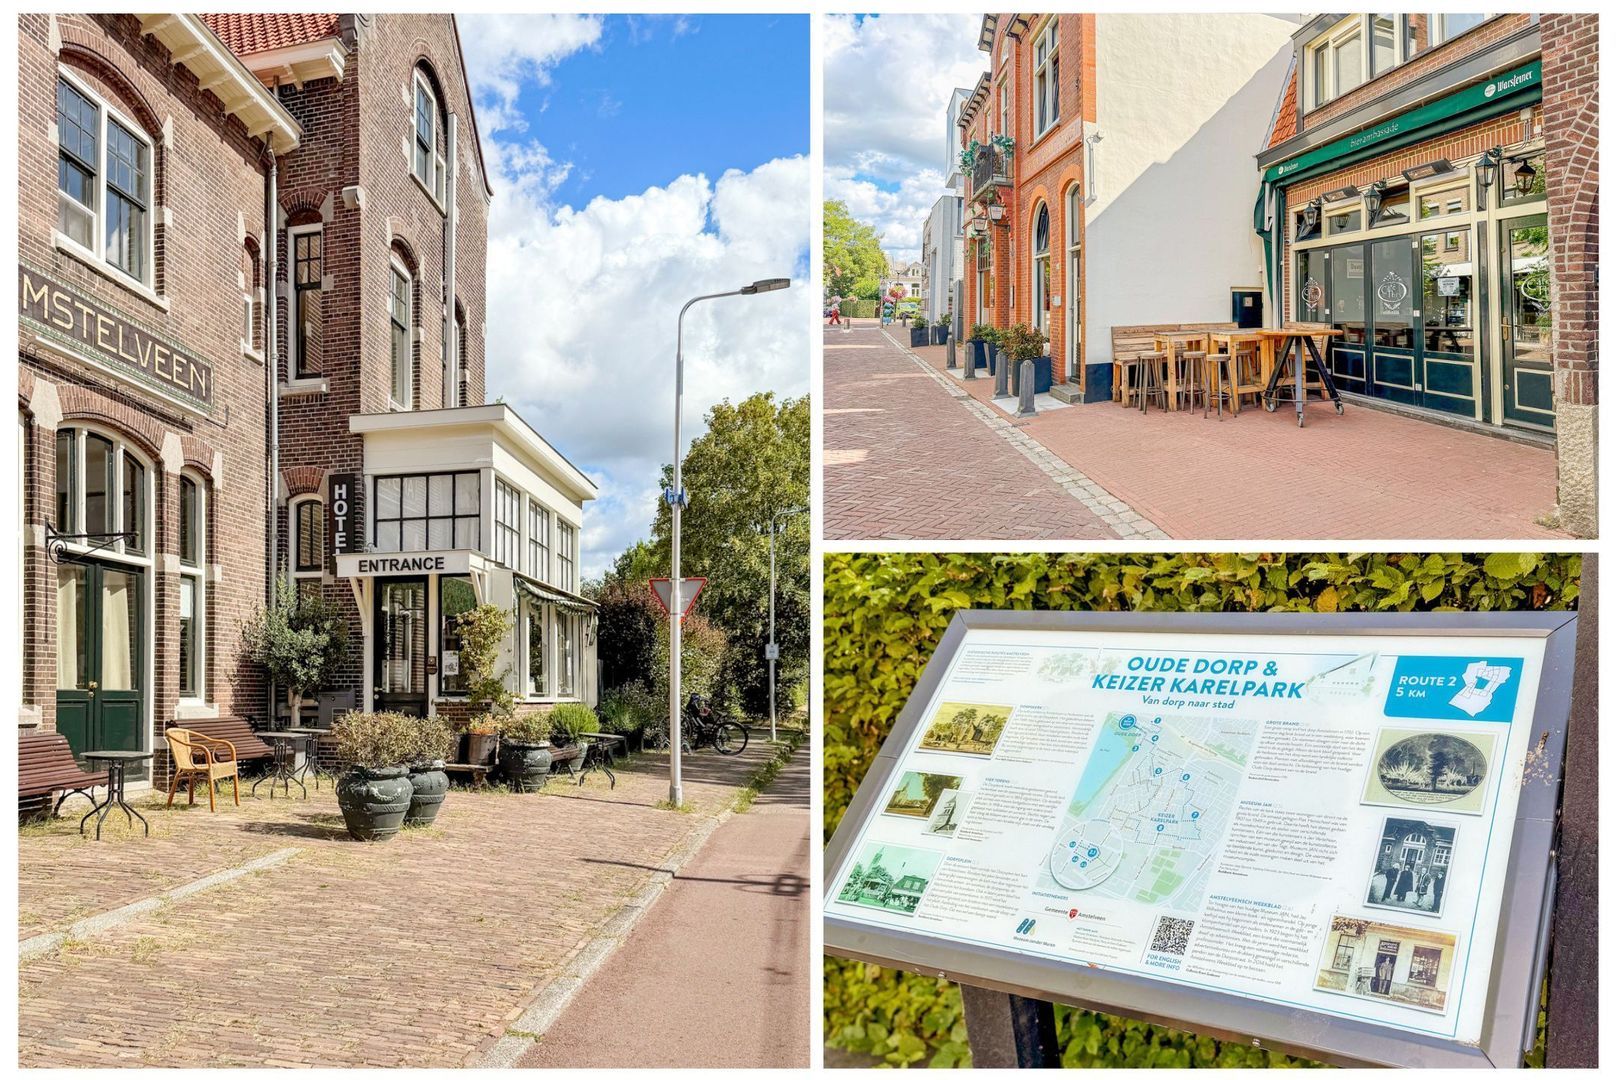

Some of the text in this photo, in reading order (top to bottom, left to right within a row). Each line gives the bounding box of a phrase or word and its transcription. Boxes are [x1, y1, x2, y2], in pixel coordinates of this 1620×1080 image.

[358, 557, 445, 573] ENTRANCE
[1127, 656, 1278, 676] OUDE DORP &
[1092, 674, 1305, 699] KEIZER KARELPARK
[1398, 676, 1457, 687] ROUTE 2
[1395, 687, 1426, 698] 5 KM
[1142, 695, 1236, 710] Van dorp naar stad
[1253, 901, 1282, 910] WEEKBLAD
[1044, 906, 1106, 921] Gemeente Amstelveen
[1147, 953, 1182, 965] FOR ENGLISH
[1149, 960, 1165, 969] MORE
[1165, 963, 1181, 971] INFO
